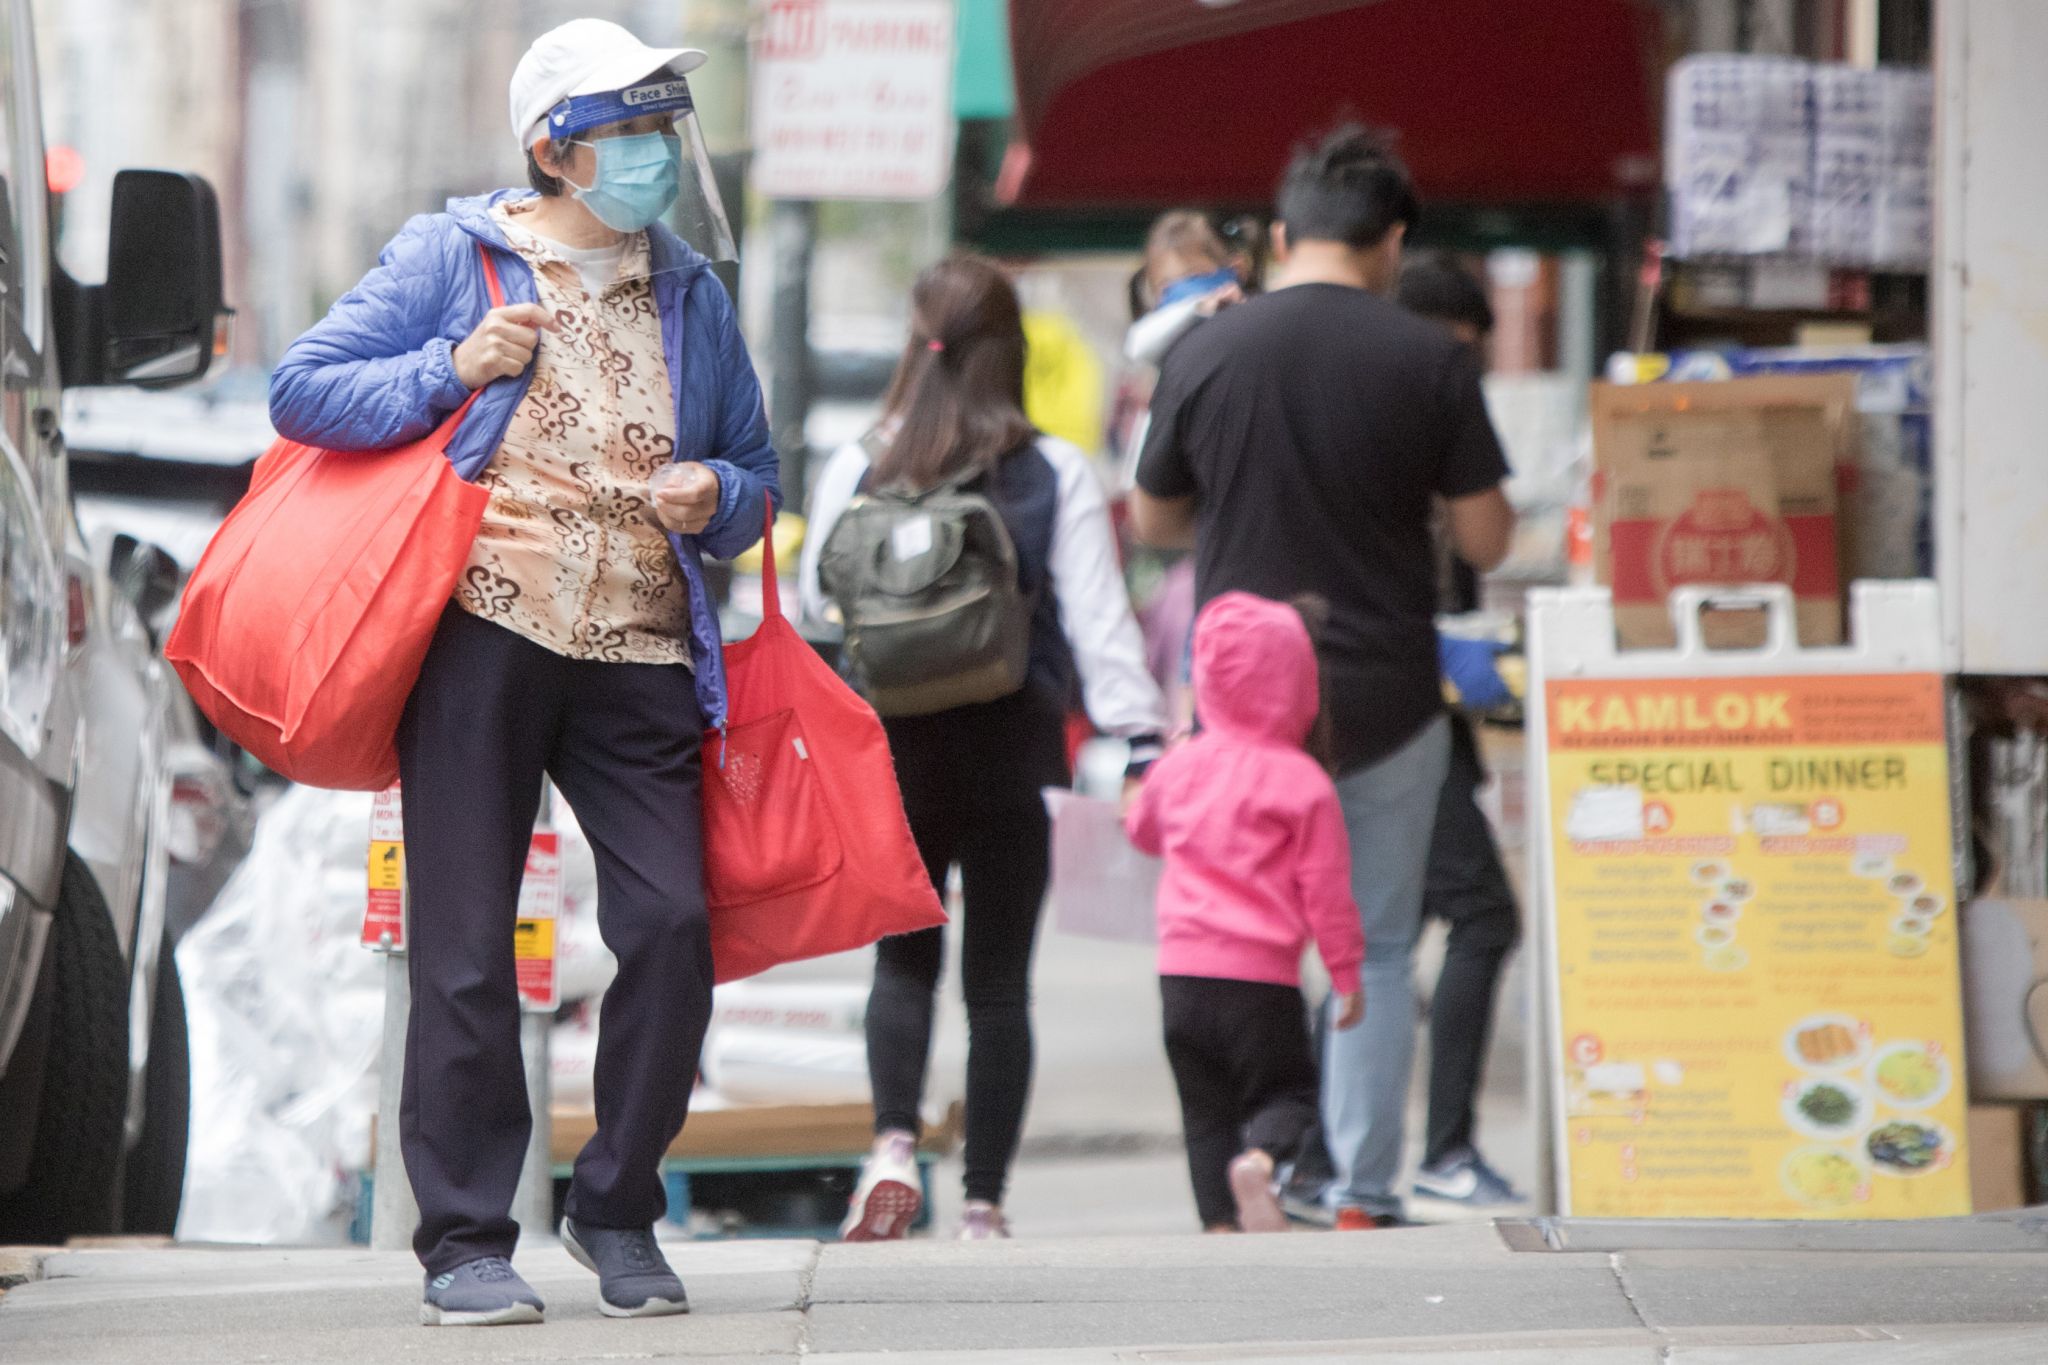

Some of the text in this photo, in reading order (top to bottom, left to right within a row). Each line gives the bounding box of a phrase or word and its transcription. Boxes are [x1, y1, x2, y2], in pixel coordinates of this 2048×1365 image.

[629, 89, 660, 103] Face
[1560, 693, 1790, 731] KAMLOK
[1588, 754, 1907, 793] SPECIAL DINNER
